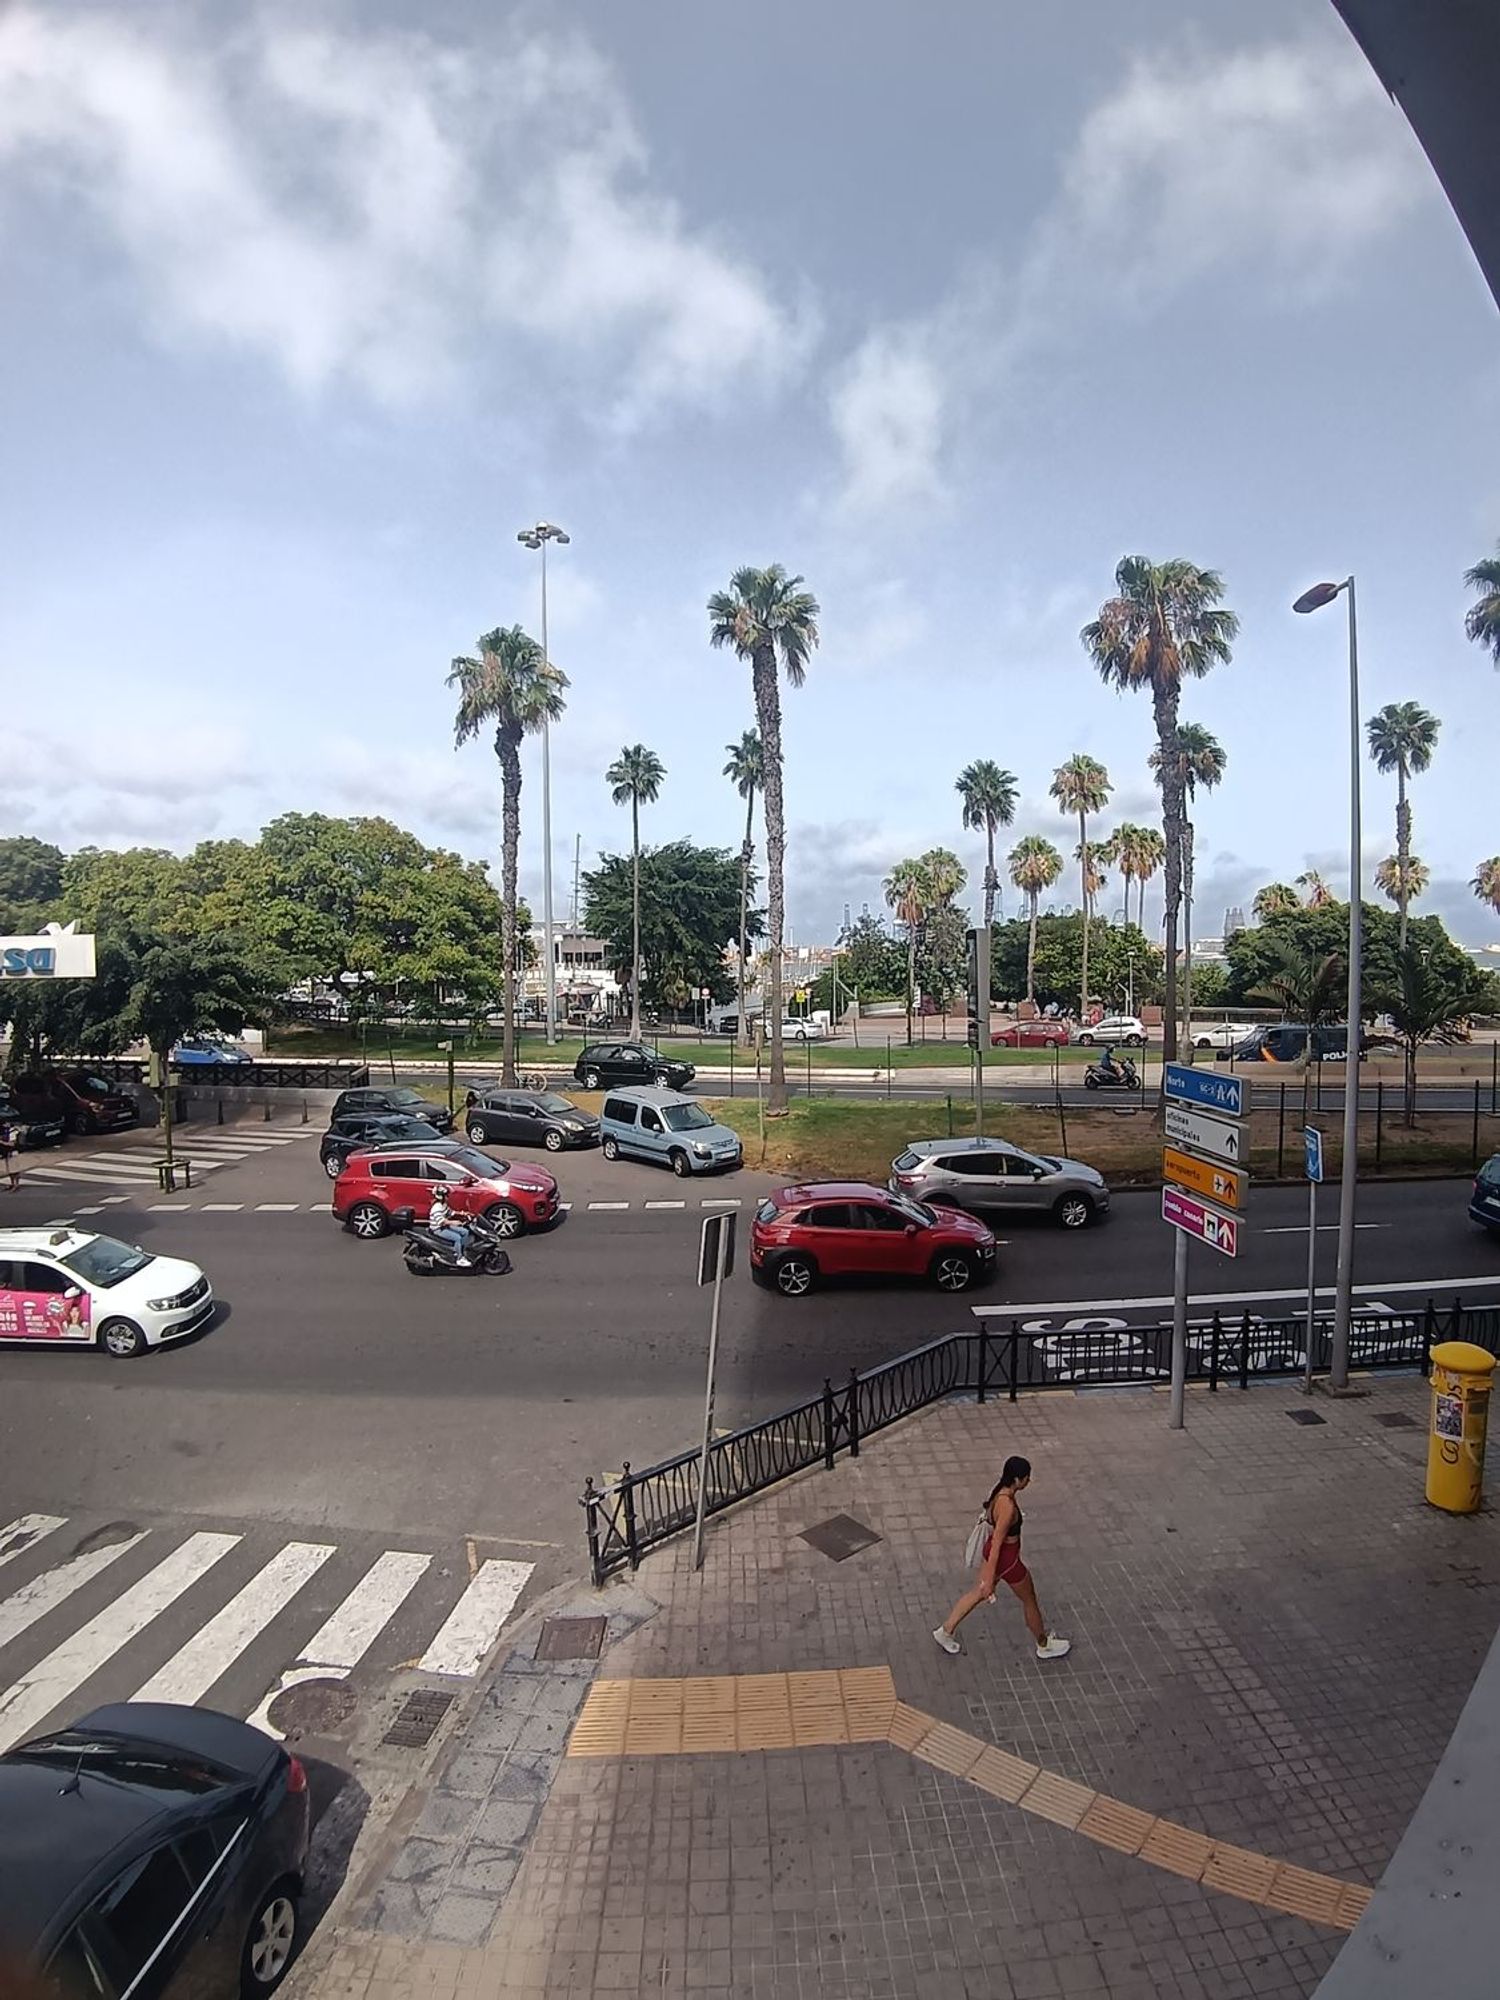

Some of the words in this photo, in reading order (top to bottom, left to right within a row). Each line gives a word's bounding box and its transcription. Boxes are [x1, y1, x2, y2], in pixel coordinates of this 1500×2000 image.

[1167, 1075, 1185, 1088] Norte
[1166, 1124, 1201, 1142] municipales
[1167, 1160, 1201, 1180] aeropuerto
[1021, 1316, 1172, 1387] SOLO
